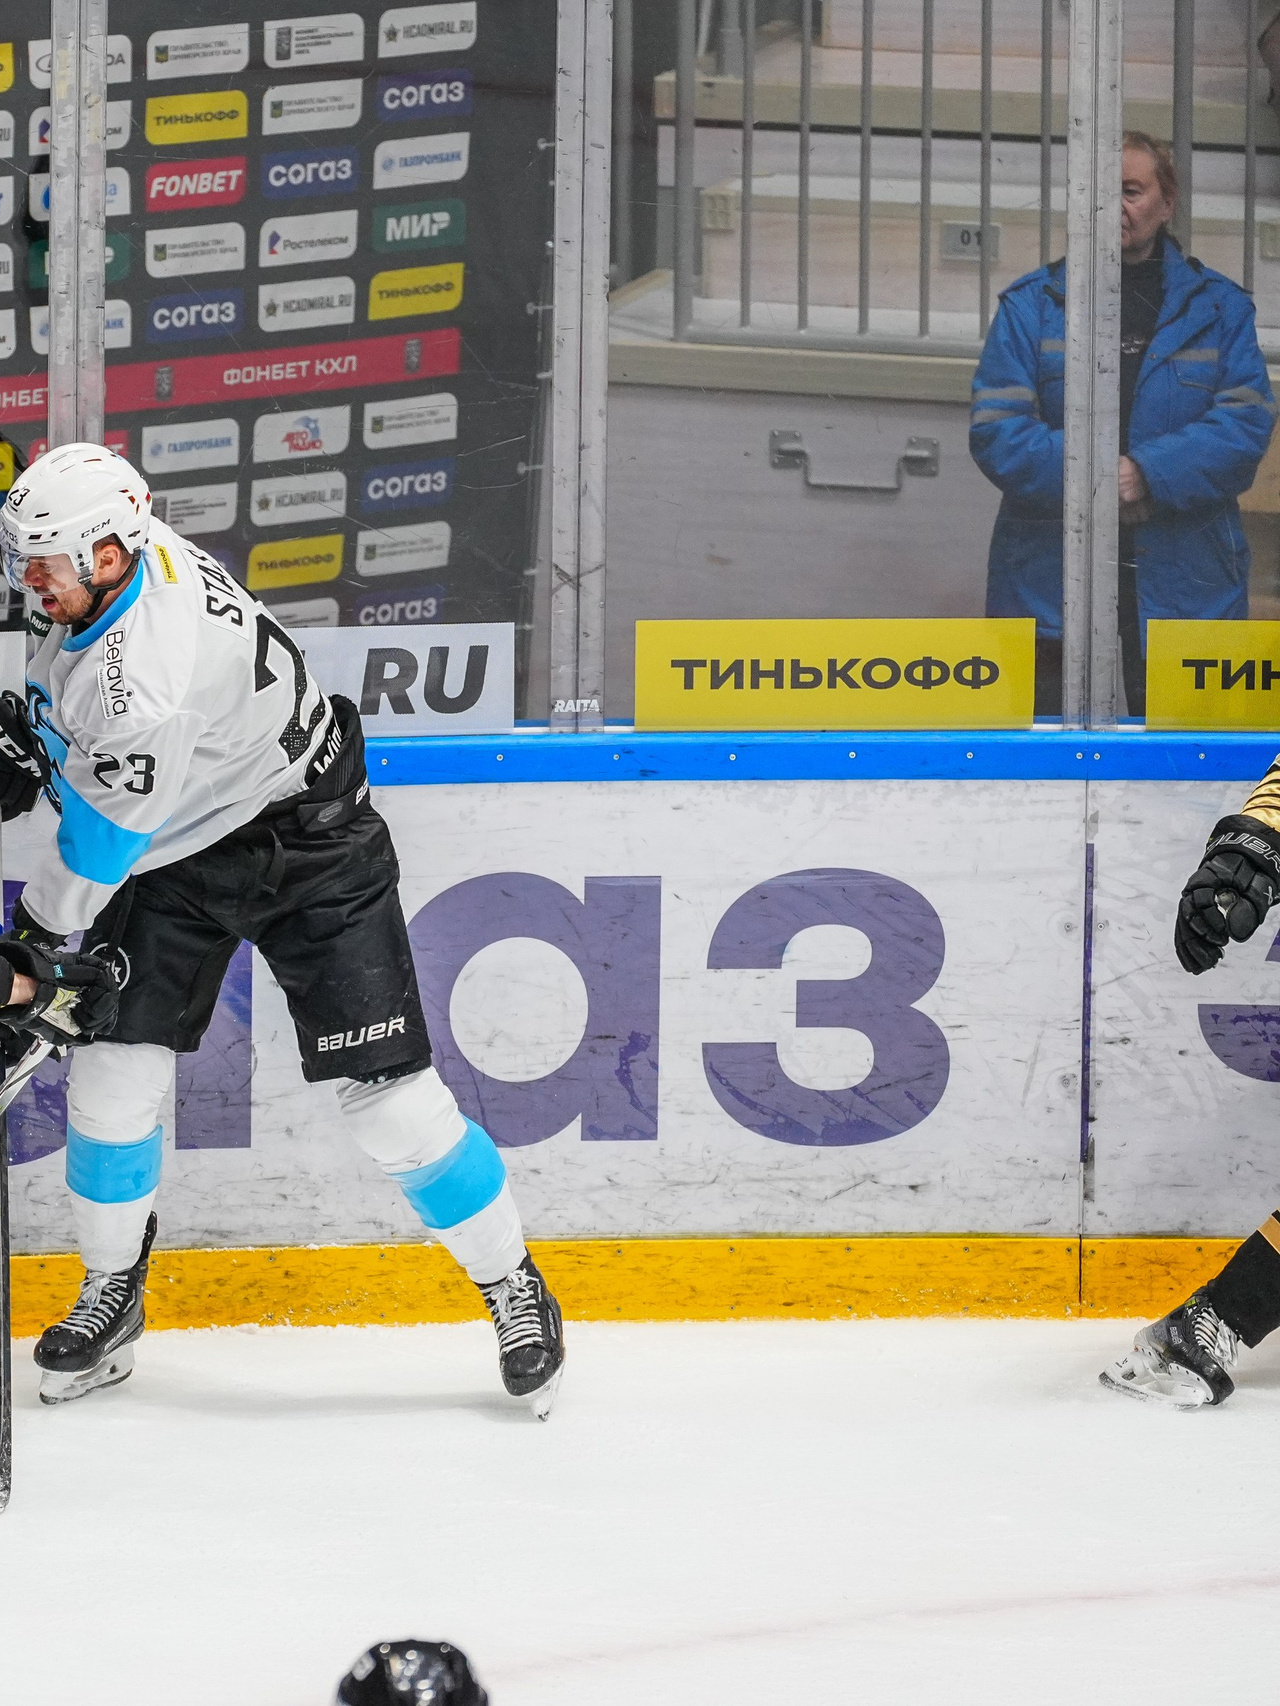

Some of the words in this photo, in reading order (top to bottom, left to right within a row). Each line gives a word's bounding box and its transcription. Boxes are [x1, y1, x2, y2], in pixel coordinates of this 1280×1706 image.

[383, 81, 465, 110] согаз
[154, 109, 240, 127] ТИНЬКОФФ
[150, 169, 243, 199] FONBET
[268, 158, 352, 187] согаз
[385, 211, 451, 243] МИР
[282, 236, 349, 251] Ростелеком
[378, 281, 454, 301] ТИНЬКОФФ
[153, 301, 236, 331] согаз
[223, 360, 310, 385] ФОНБЕТ
[315, 355, 358, 375] КХЛ
[366, 470, 448, 500] согаз
[80, 518, 111, 539] CCM
[257, 553, 336, 572] ТИНЬКОФФ
[358, 597, 438, 626] согаз
[105, 630, 128, 716] Belavia
[670, 656, 1000, 690] ТИНЬКОФФ
[554, 698, 601, 713] RAITA
[91, 752, 157, 796] 23
